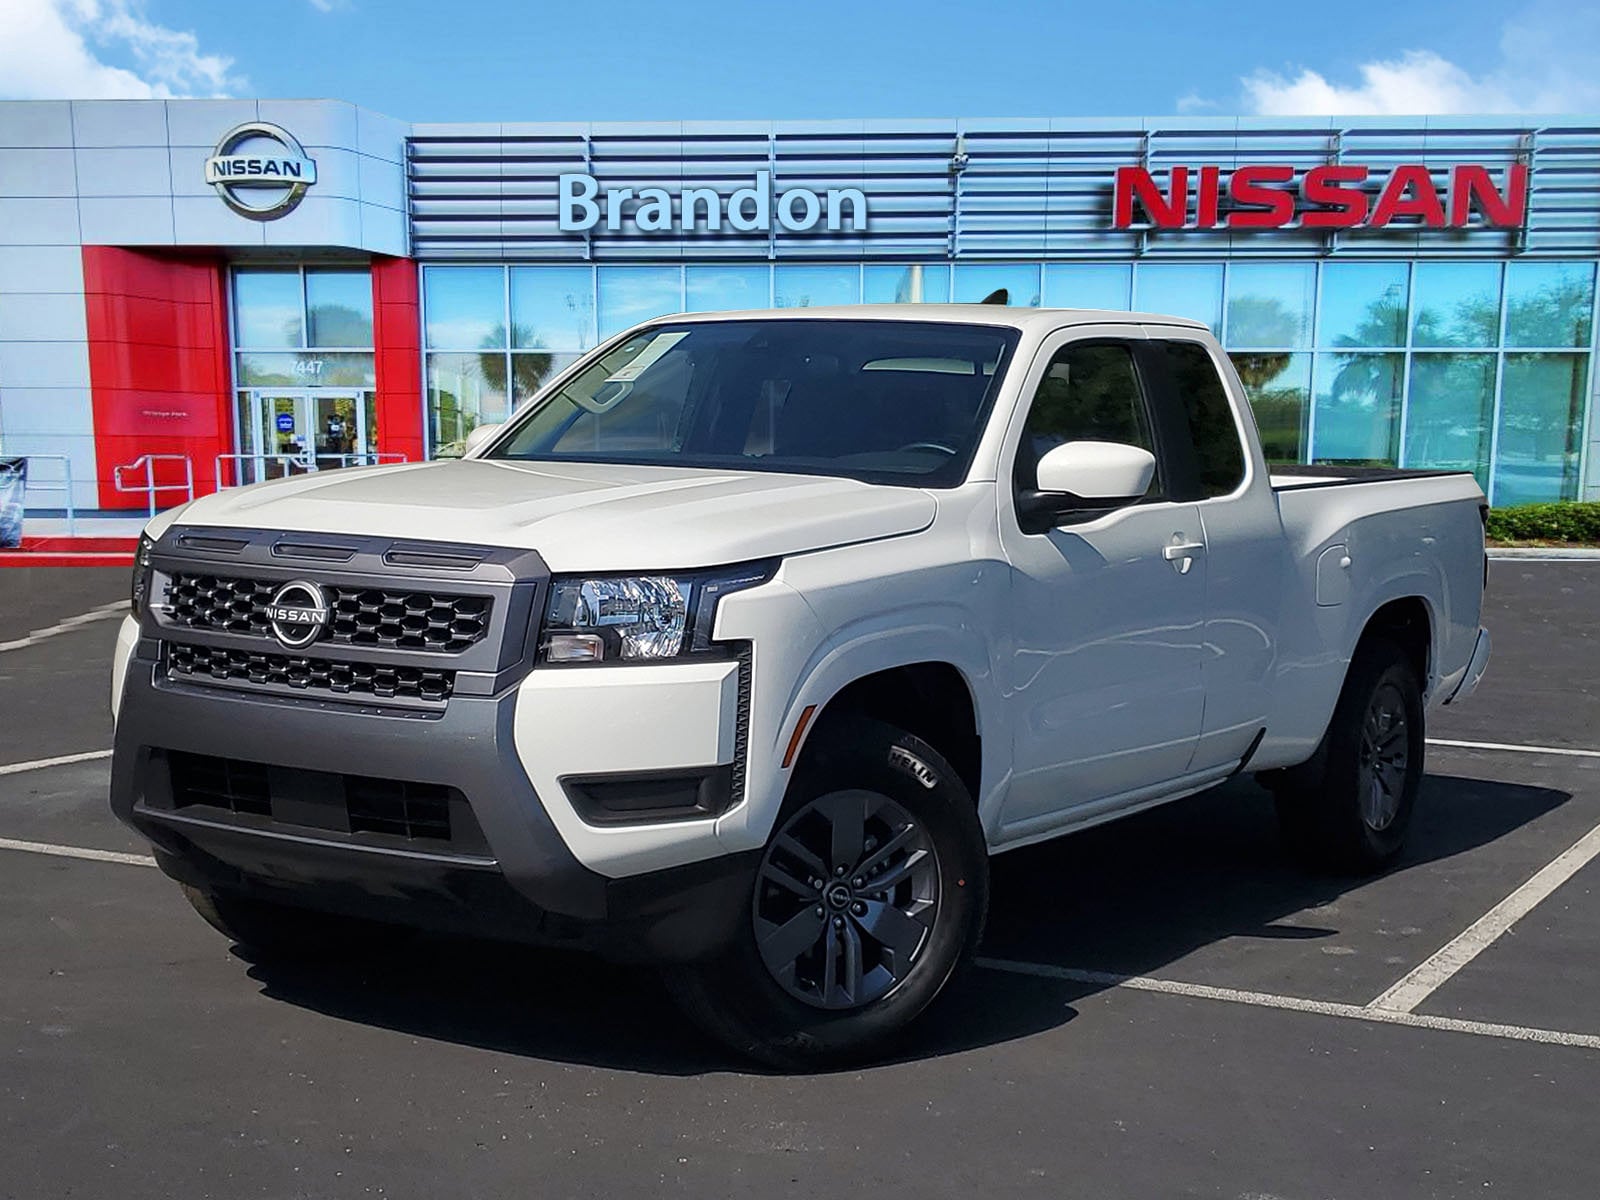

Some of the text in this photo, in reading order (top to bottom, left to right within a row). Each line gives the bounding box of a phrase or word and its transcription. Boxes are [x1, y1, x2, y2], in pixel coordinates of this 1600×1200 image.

[213, 159, 301, 177] NISSAN
[558, 170, 868, 231] Brandon
[1113, 164, 1528, 229] NISSAN
[265, 607, 325, 623] NISSAN
